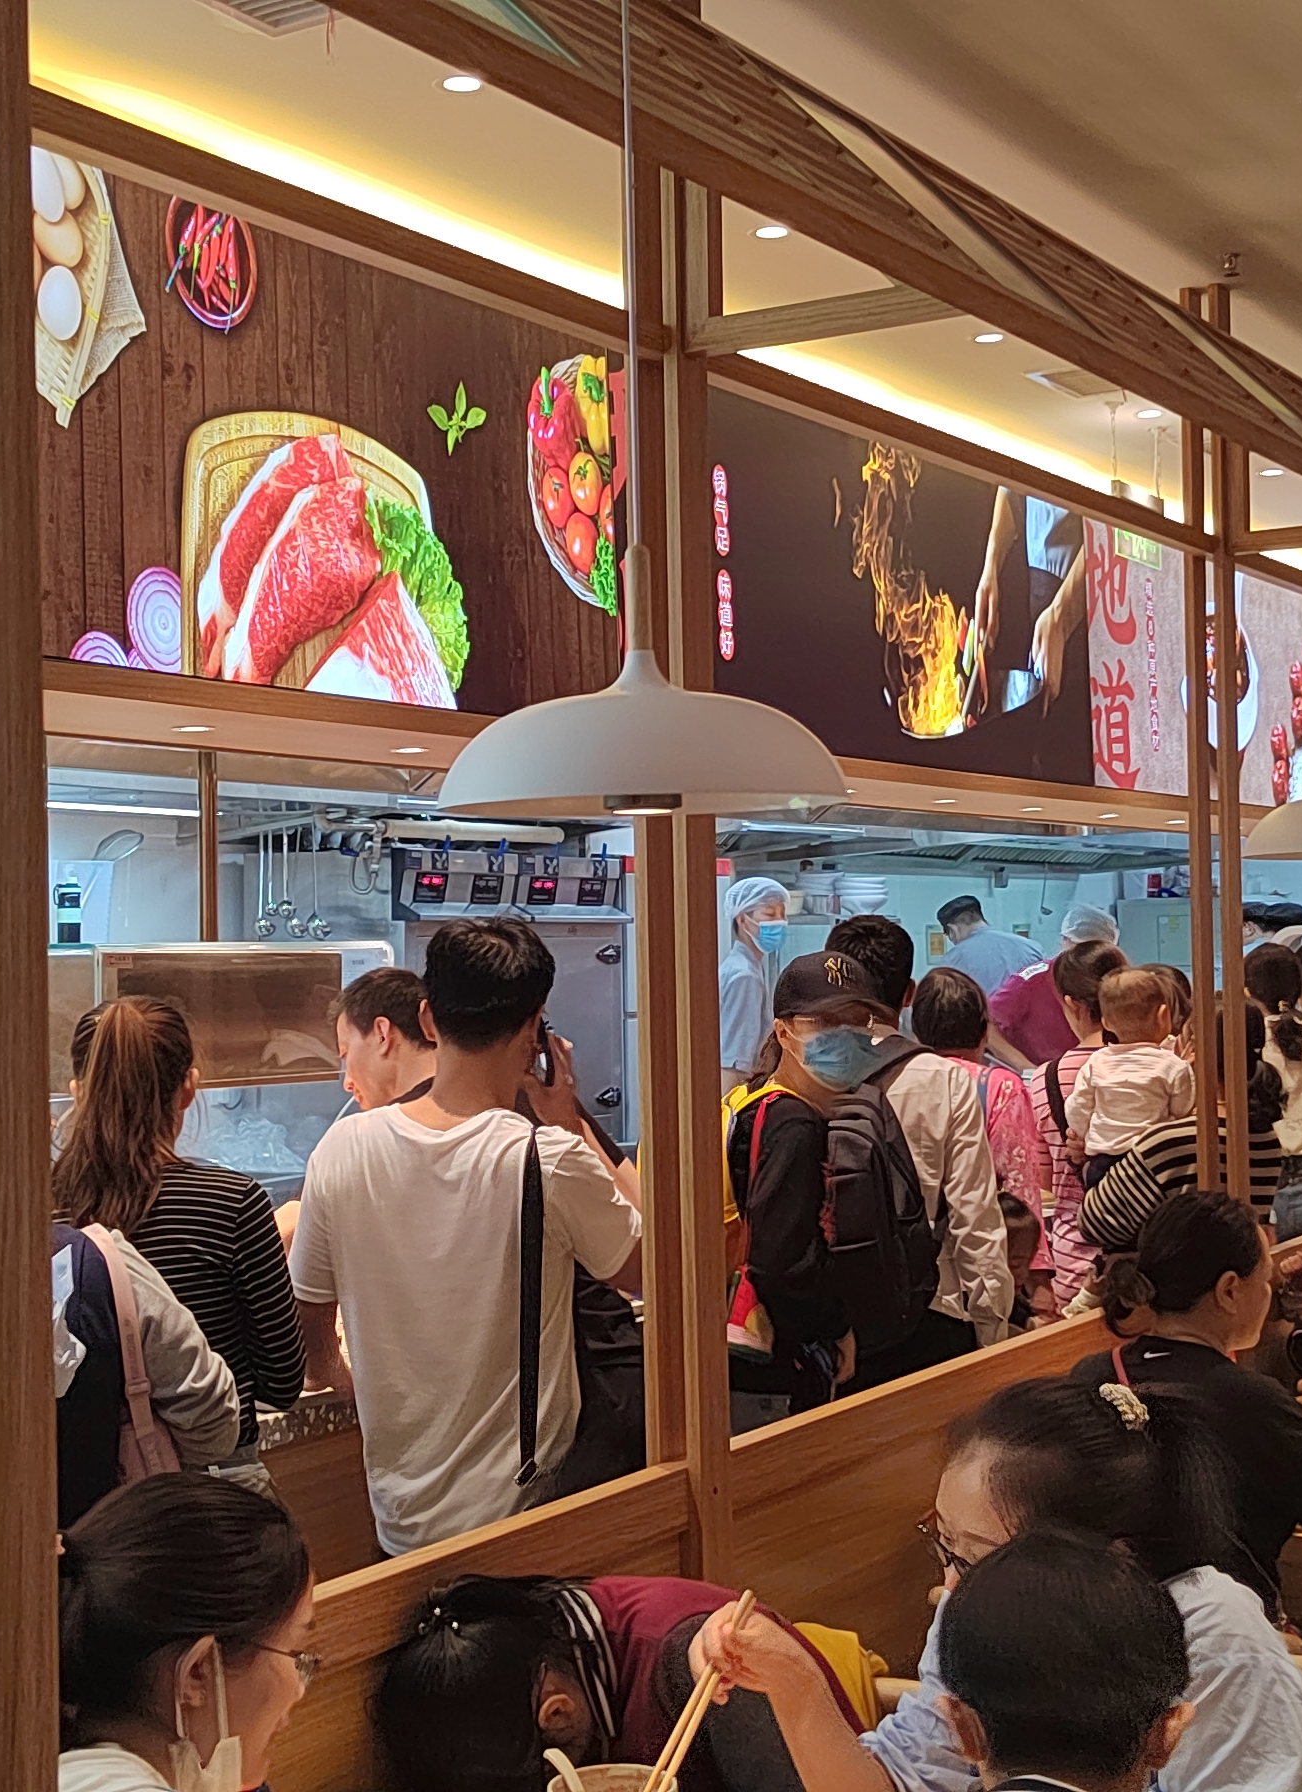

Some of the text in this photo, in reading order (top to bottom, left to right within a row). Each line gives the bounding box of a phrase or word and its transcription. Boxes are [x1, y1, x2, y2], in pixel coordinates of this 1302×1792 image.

[717, 570, 734, 658] 味道好
[1083, 517, 1141, 790] 地道
